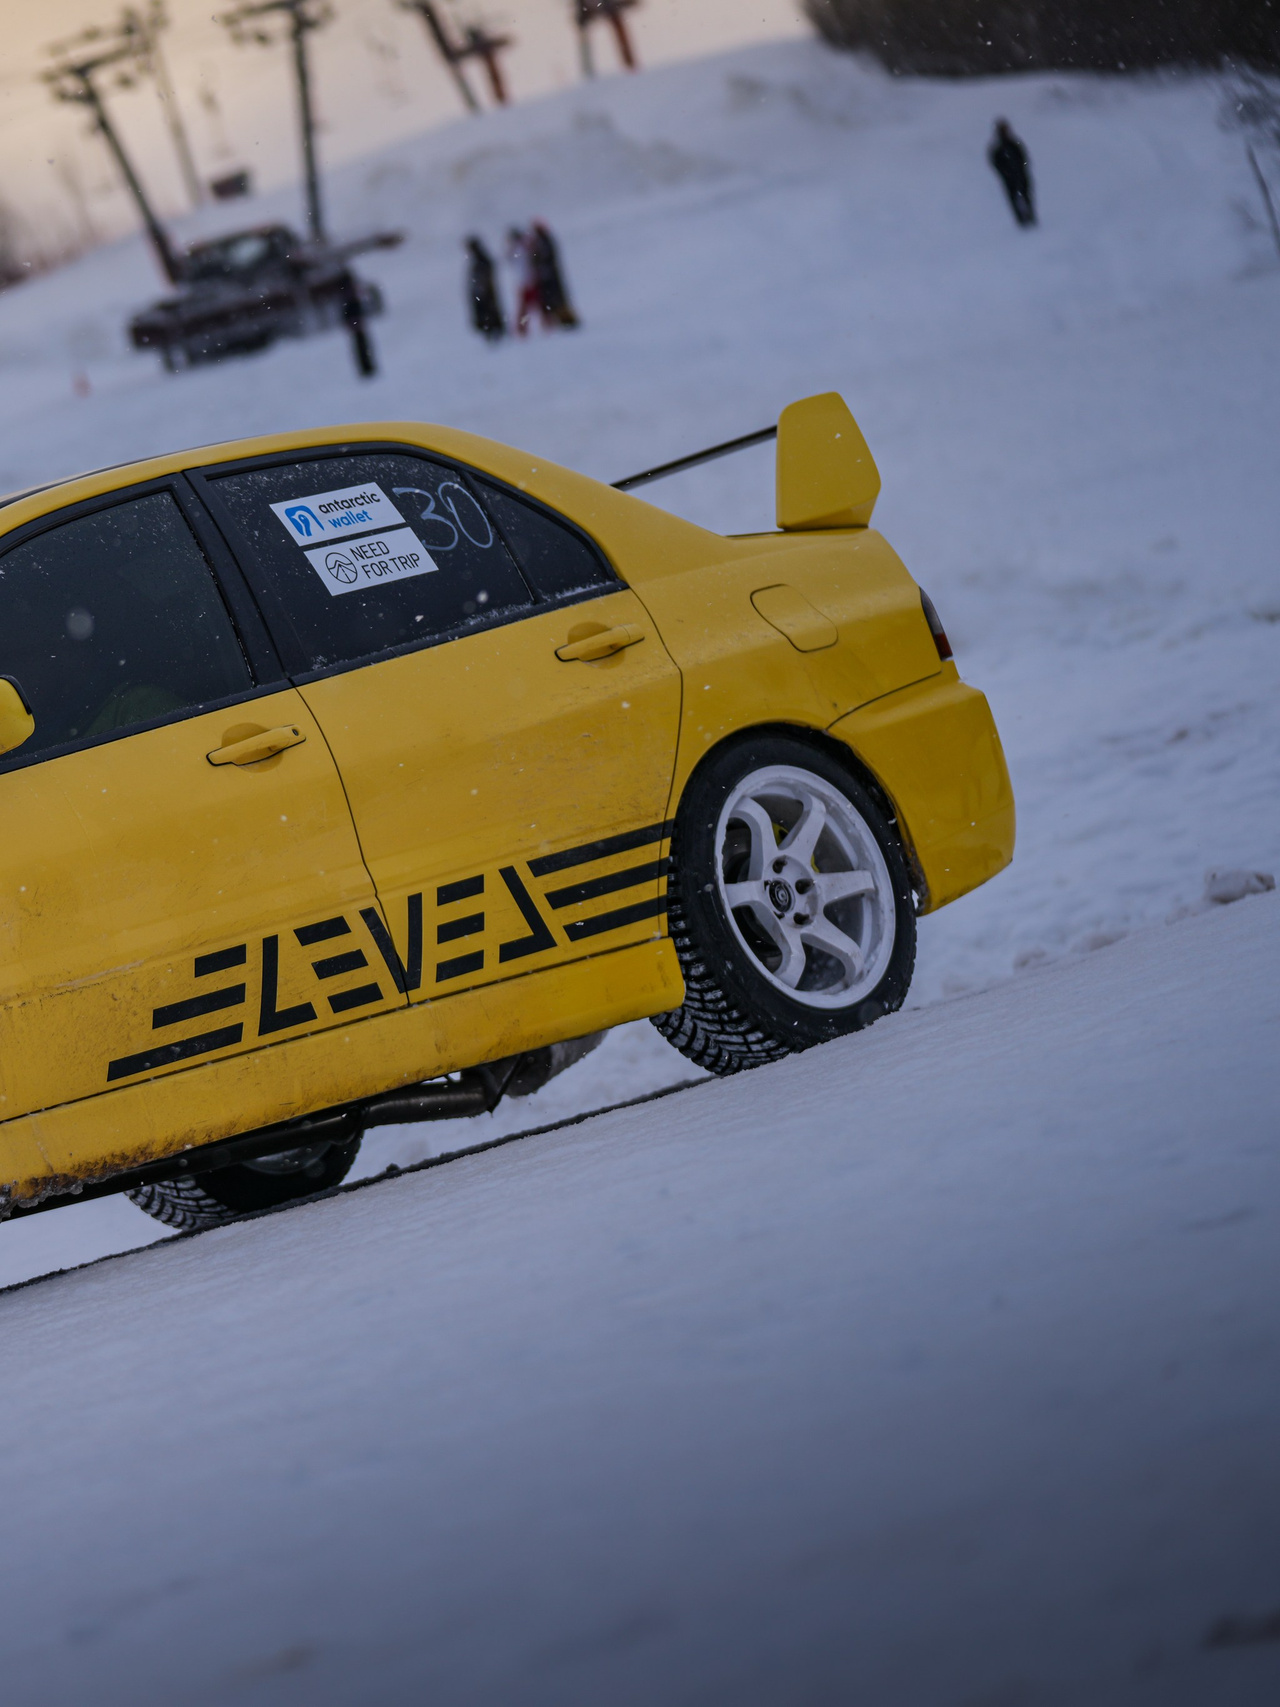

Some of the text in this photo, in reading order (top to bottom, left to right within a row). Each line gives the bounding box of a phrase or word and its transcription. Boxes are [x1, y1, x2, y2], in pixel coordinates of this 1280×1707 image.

[318, 491, 381, 514] antarctic
[328, 509, 373, 529] wallet
[392, 482, 493, 550] 30
[349, 540, 390, 562] NEED
[361, 553, 420, 579] FOR TRIP
